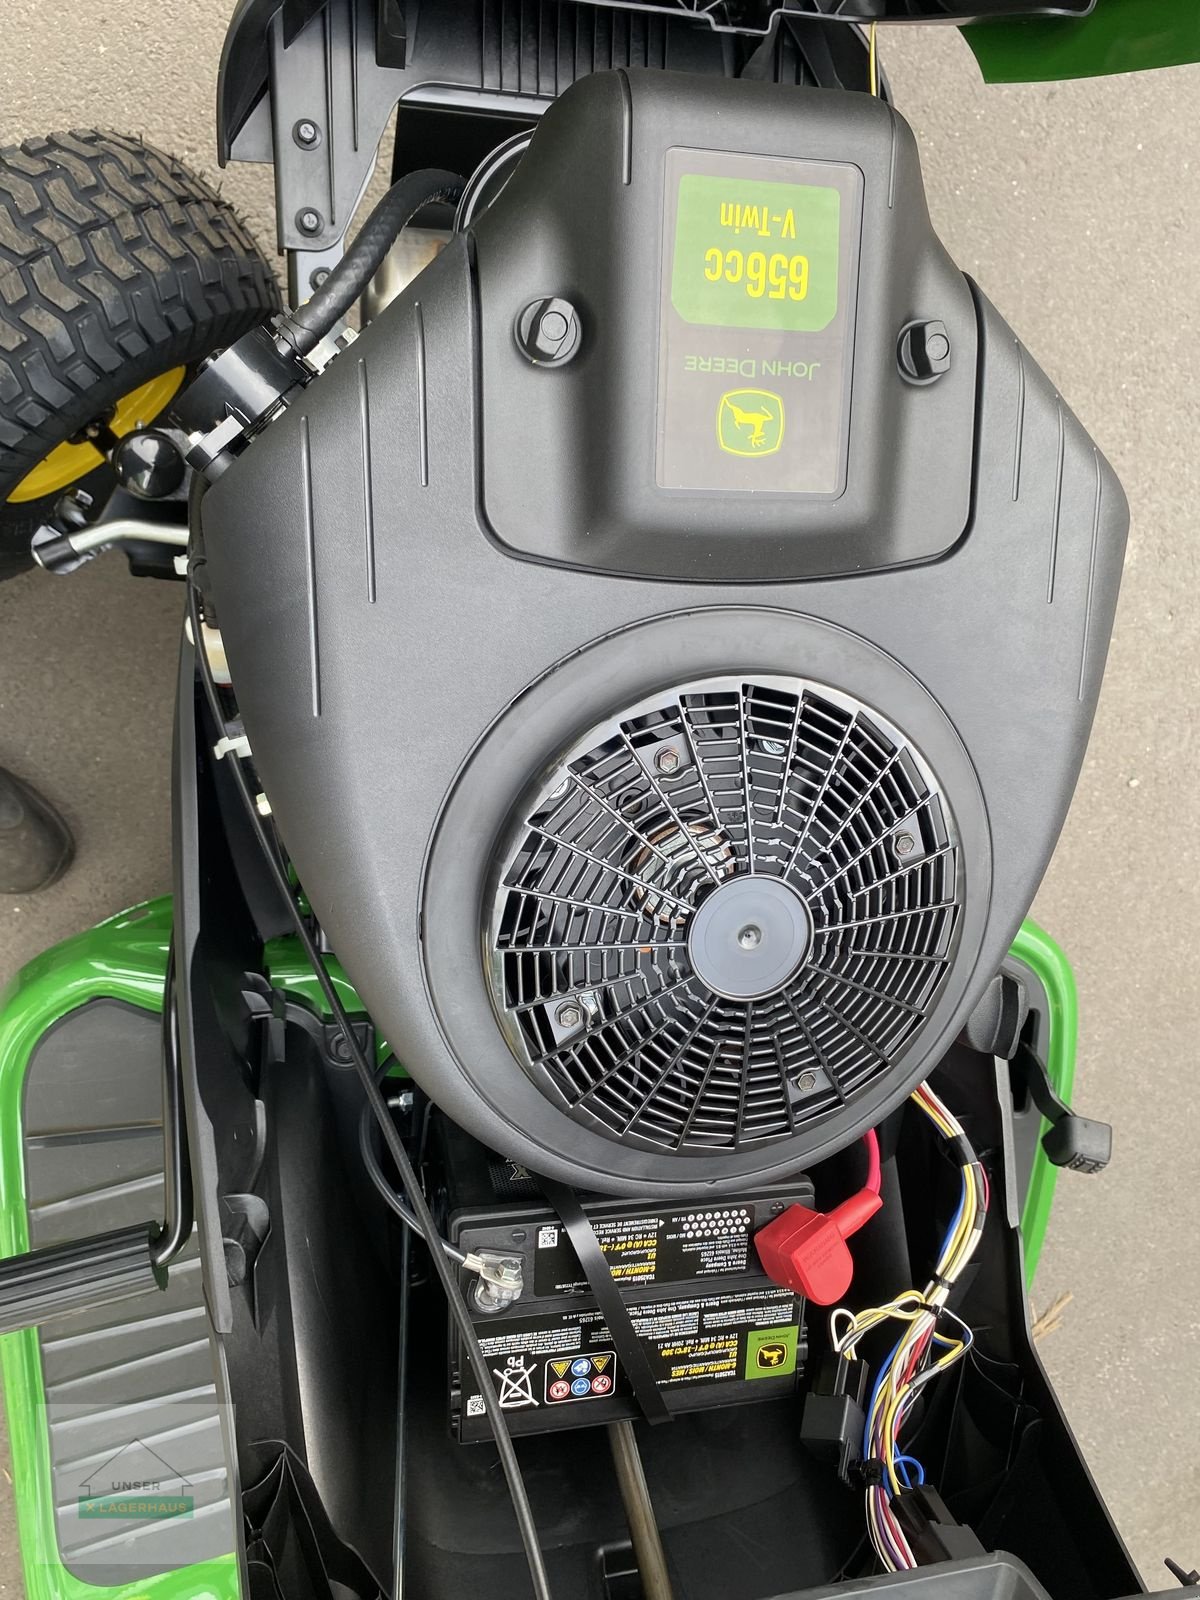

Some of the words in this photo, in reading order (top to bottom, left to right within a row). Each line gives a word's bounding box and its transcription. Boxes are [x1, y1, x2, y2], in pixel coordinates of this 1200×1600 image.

[720, 202, 796, 239] V-Twin
[704, 247, 809, 301] 656cc
[684, 355, 756, 378] DEERE
[762, 360, 821, 381] JOHN
[705, 1260, 726, 1268] Company
[627, 1265, 655, 1274] 6-MONTH
[677, 1302, 699, 1310] Company,
[726, 1339, 737, 1347] CCA
[661, 1348, 673, 1356] 300
[507, 1355, 523, 1367] Pb
[689, 1366, 704, 1374] MOIS
[708, 1362, 735, 1371] 6-MONTH
